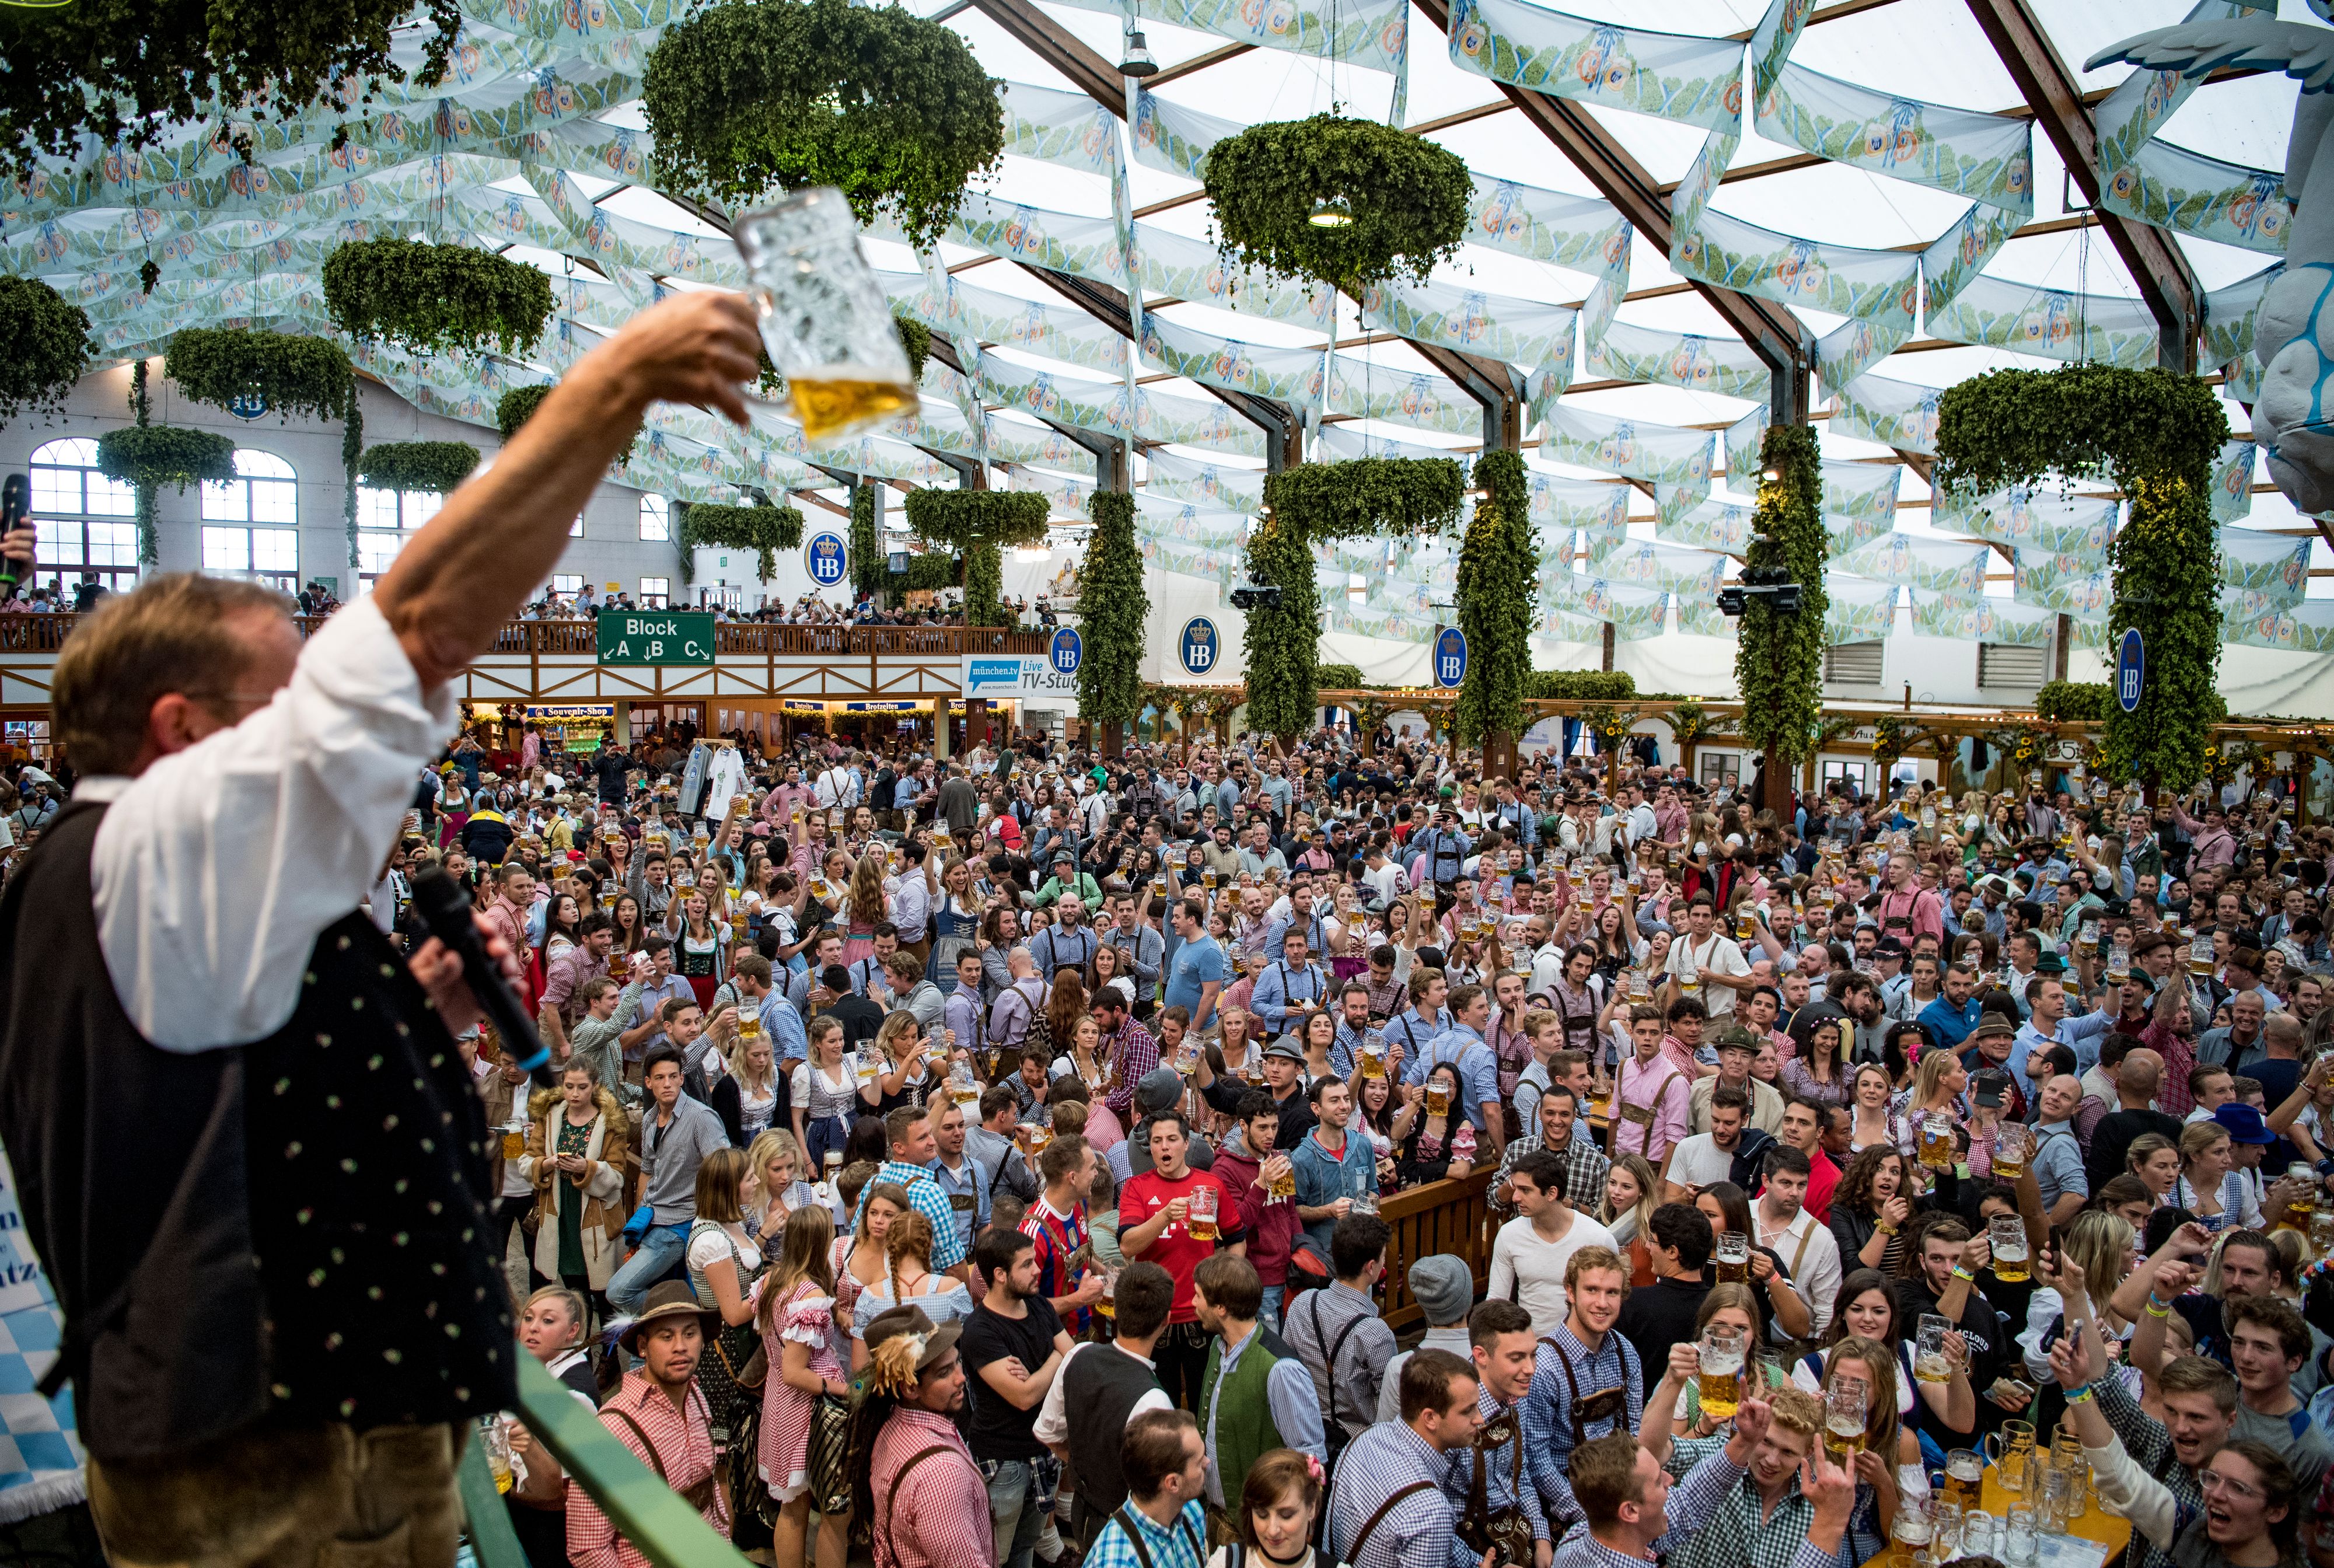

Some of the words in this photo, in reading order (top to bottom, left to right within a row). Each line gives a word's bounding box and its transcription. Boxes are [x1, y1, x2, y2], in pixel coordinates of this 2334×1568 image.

[817, 558, 838, 577] HB
[627, 619, 677, 635] Block
[617, 641, 630, 656] A
[652, 641, 663, 656] B
[685, 641, 698, 656] C
[1189, 645, 1210, 666] HB
[1023, 661, 1043, 671] Live
[1058, 651, 1075, 668] HB
[1442, 656, 1460, 678] HB
[973, 666, 1018, 675] münchen.tv
[1022, 673, 1079, 689] TV-Stud
[2123, 669, 2138, 699] HB
[548, 708, 607, 716] Souvenir-Shop
[1199, 699, 1206, 711] 3
[1853, 730, 1874, 739] Aus
[2061, 742, 2076, 759] 5
[1959, 1329, 1989, 1350] CLOUD
[1969, 1341, 1983, 1352] MPANY
